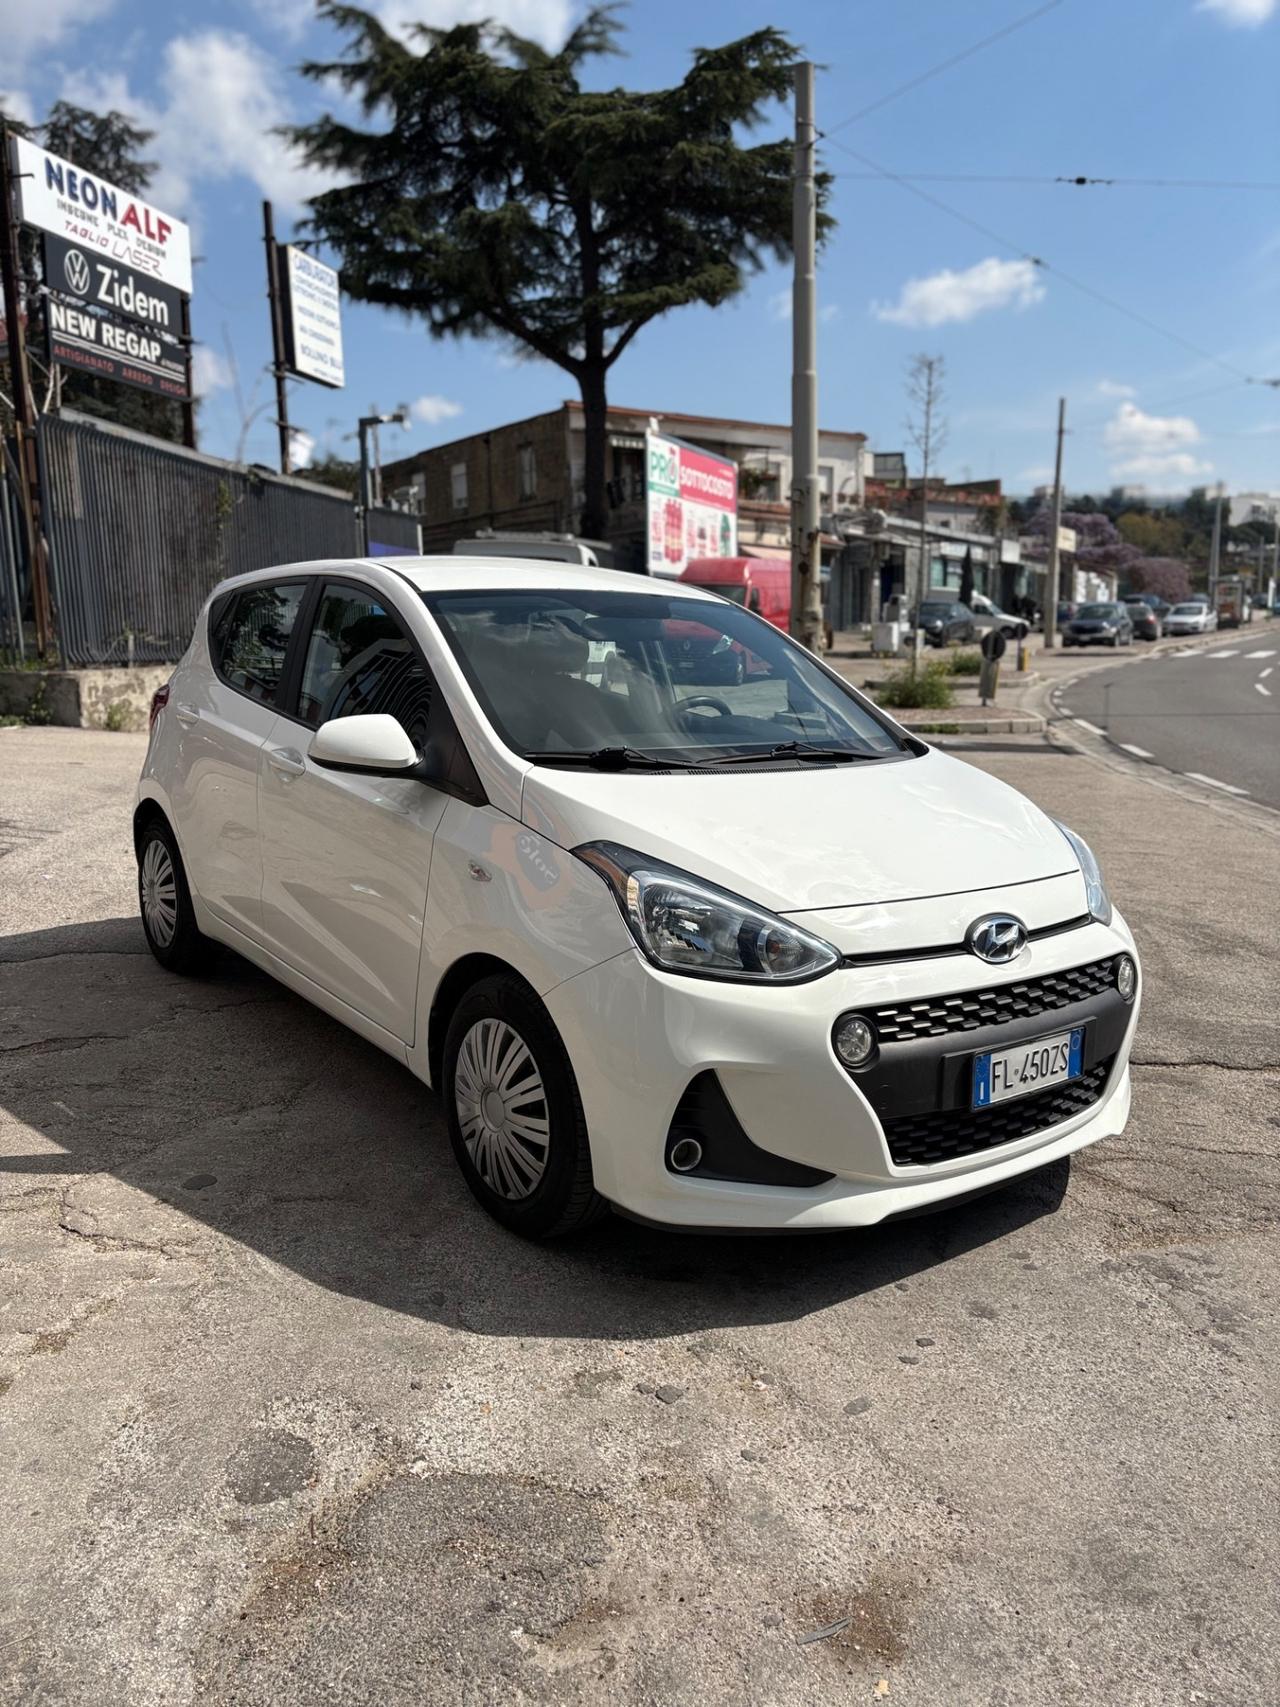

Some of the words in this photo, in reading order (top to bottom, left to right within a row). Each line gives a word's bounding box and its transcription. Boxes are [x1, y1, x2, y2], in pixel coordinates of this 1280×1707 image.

[64, 220, 109, 248] TAGLIO
[112, 241, 163, 277] LASER
[96, 264, 169, 326] Zidem
[50, 303, 96, 341] NEW
[101, 322, 161, 364] REGAP
[53, 345, 114, 373] ARTIGIANATO
[680, 466, 734, 500] SOTTOCOSTO
